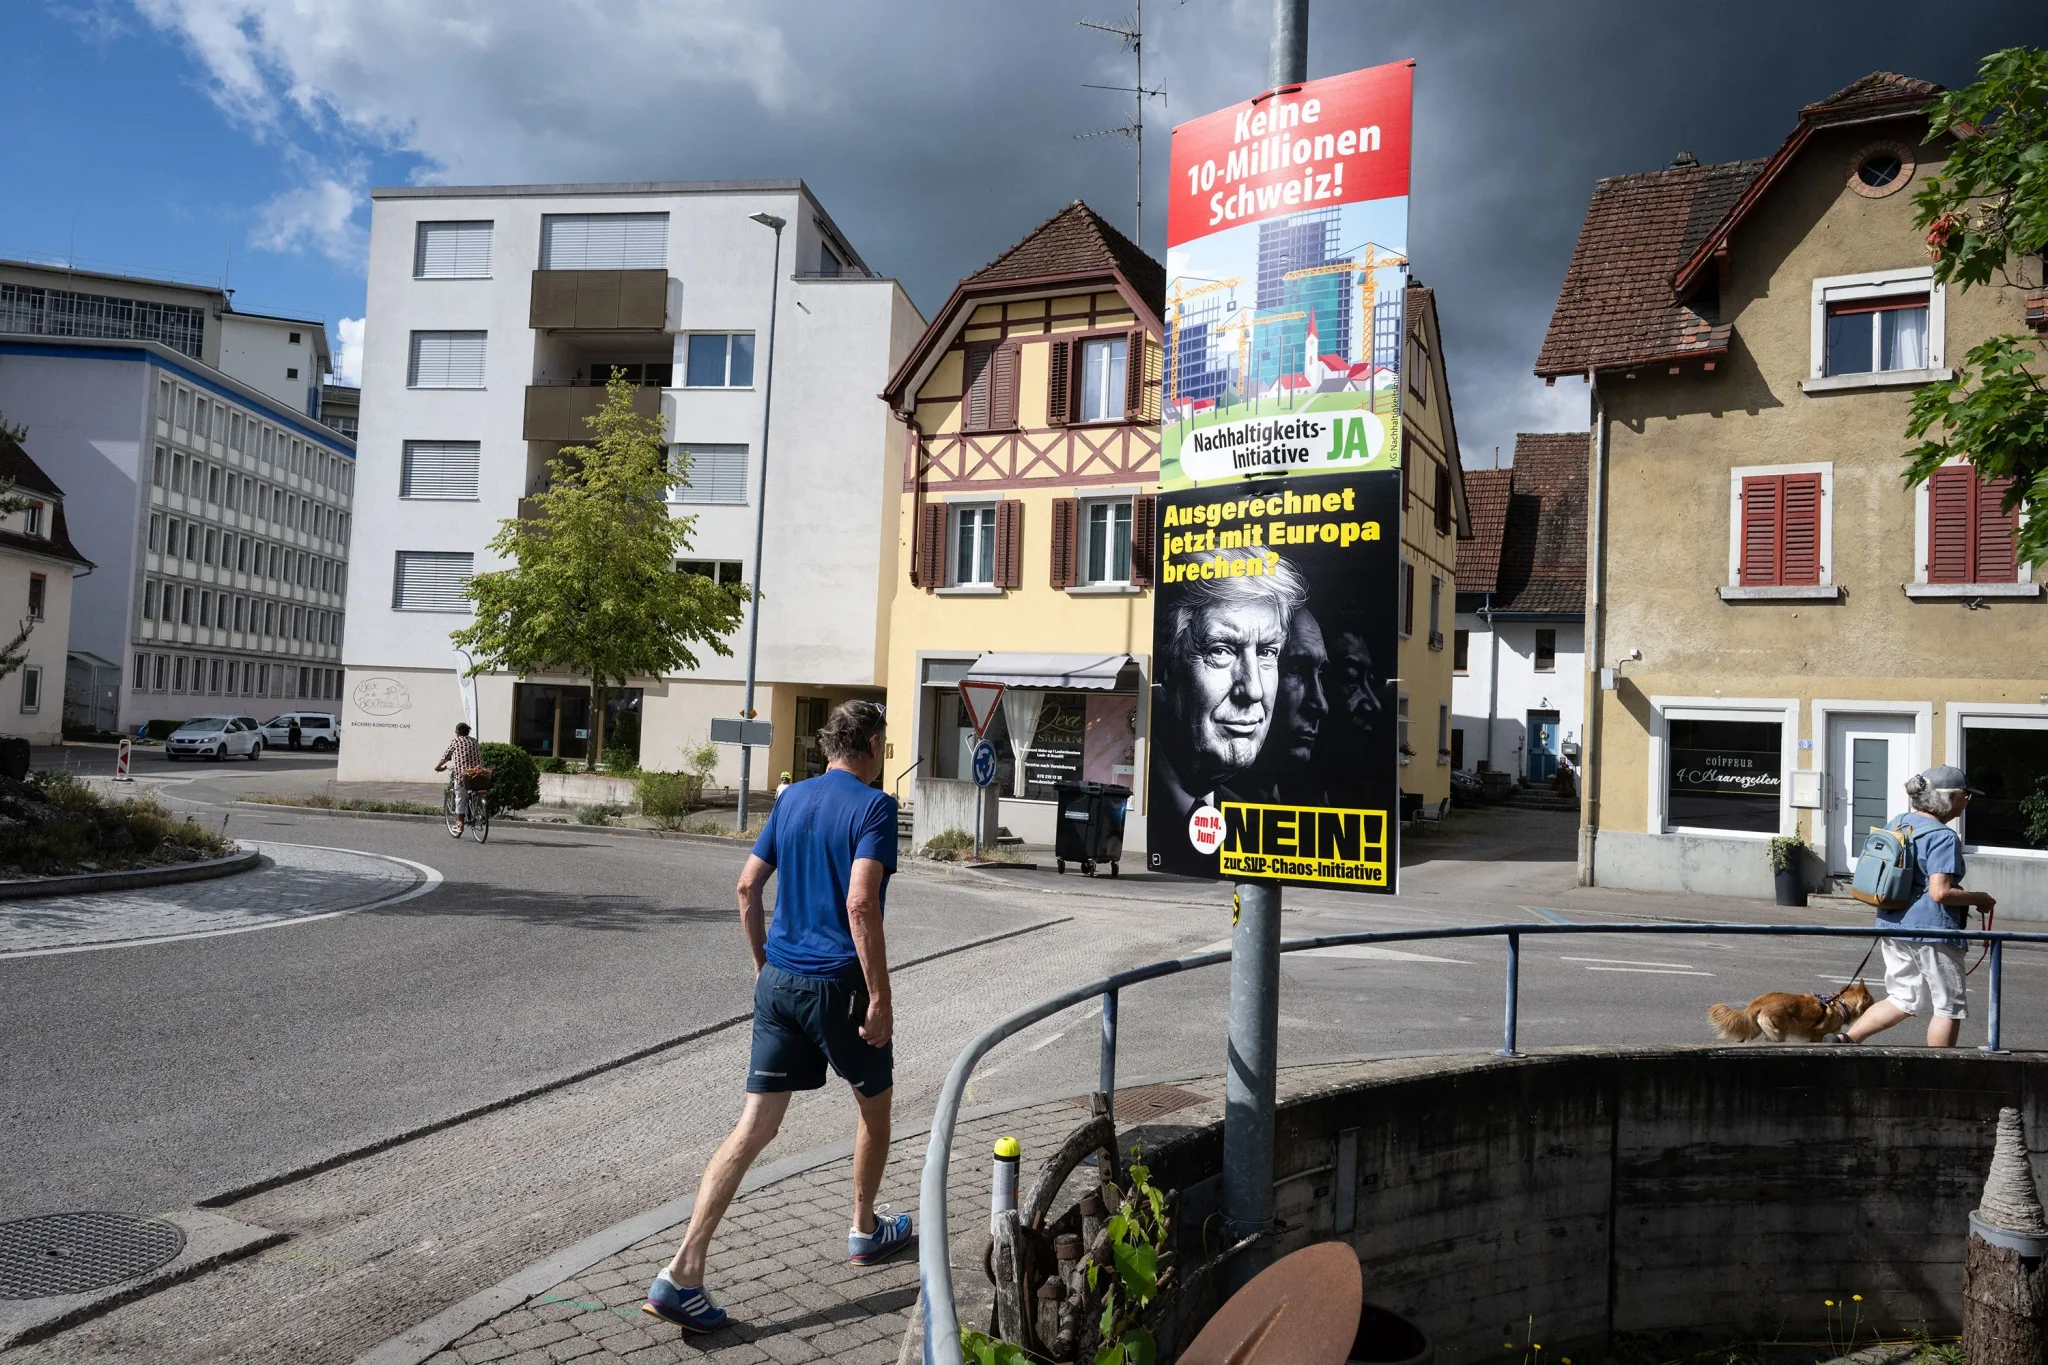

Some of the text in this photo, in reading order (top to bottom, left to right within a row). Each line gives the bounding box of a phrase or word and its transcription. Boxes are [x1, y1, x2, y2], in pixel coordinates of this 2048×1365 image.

[1233, 98, 1321, 145] Keine
[1187, 125, 1381, 196] 10-Millionen
[1208, 162, 1344, 227] Schweiz!
[1193, 418, 1327, 454] Nachhaltigkeits-
[1326, 416, 1369, 461] JA
[1232, 444, 1310, 469] Initiative
[1390, 452, 1398, 462] IG
[1163, 487, 1355, 528] Ausgerechnet
[1162, 520, 1381, 561] jetzt mit Europa
[1162, 551, 1280, 584] brechen?
[1802, 740, 1808, 748] 3
[1051, 763, 1076, 771] Vereinbarung
[1194, 815, 1222, 830] am 14.
[1196, 829, 1216, 845] Juni
[1224, 807, 1383, 863] NEIN!
[1223, 856, 1383, 881] zur SVP-Chaos-Initiative
